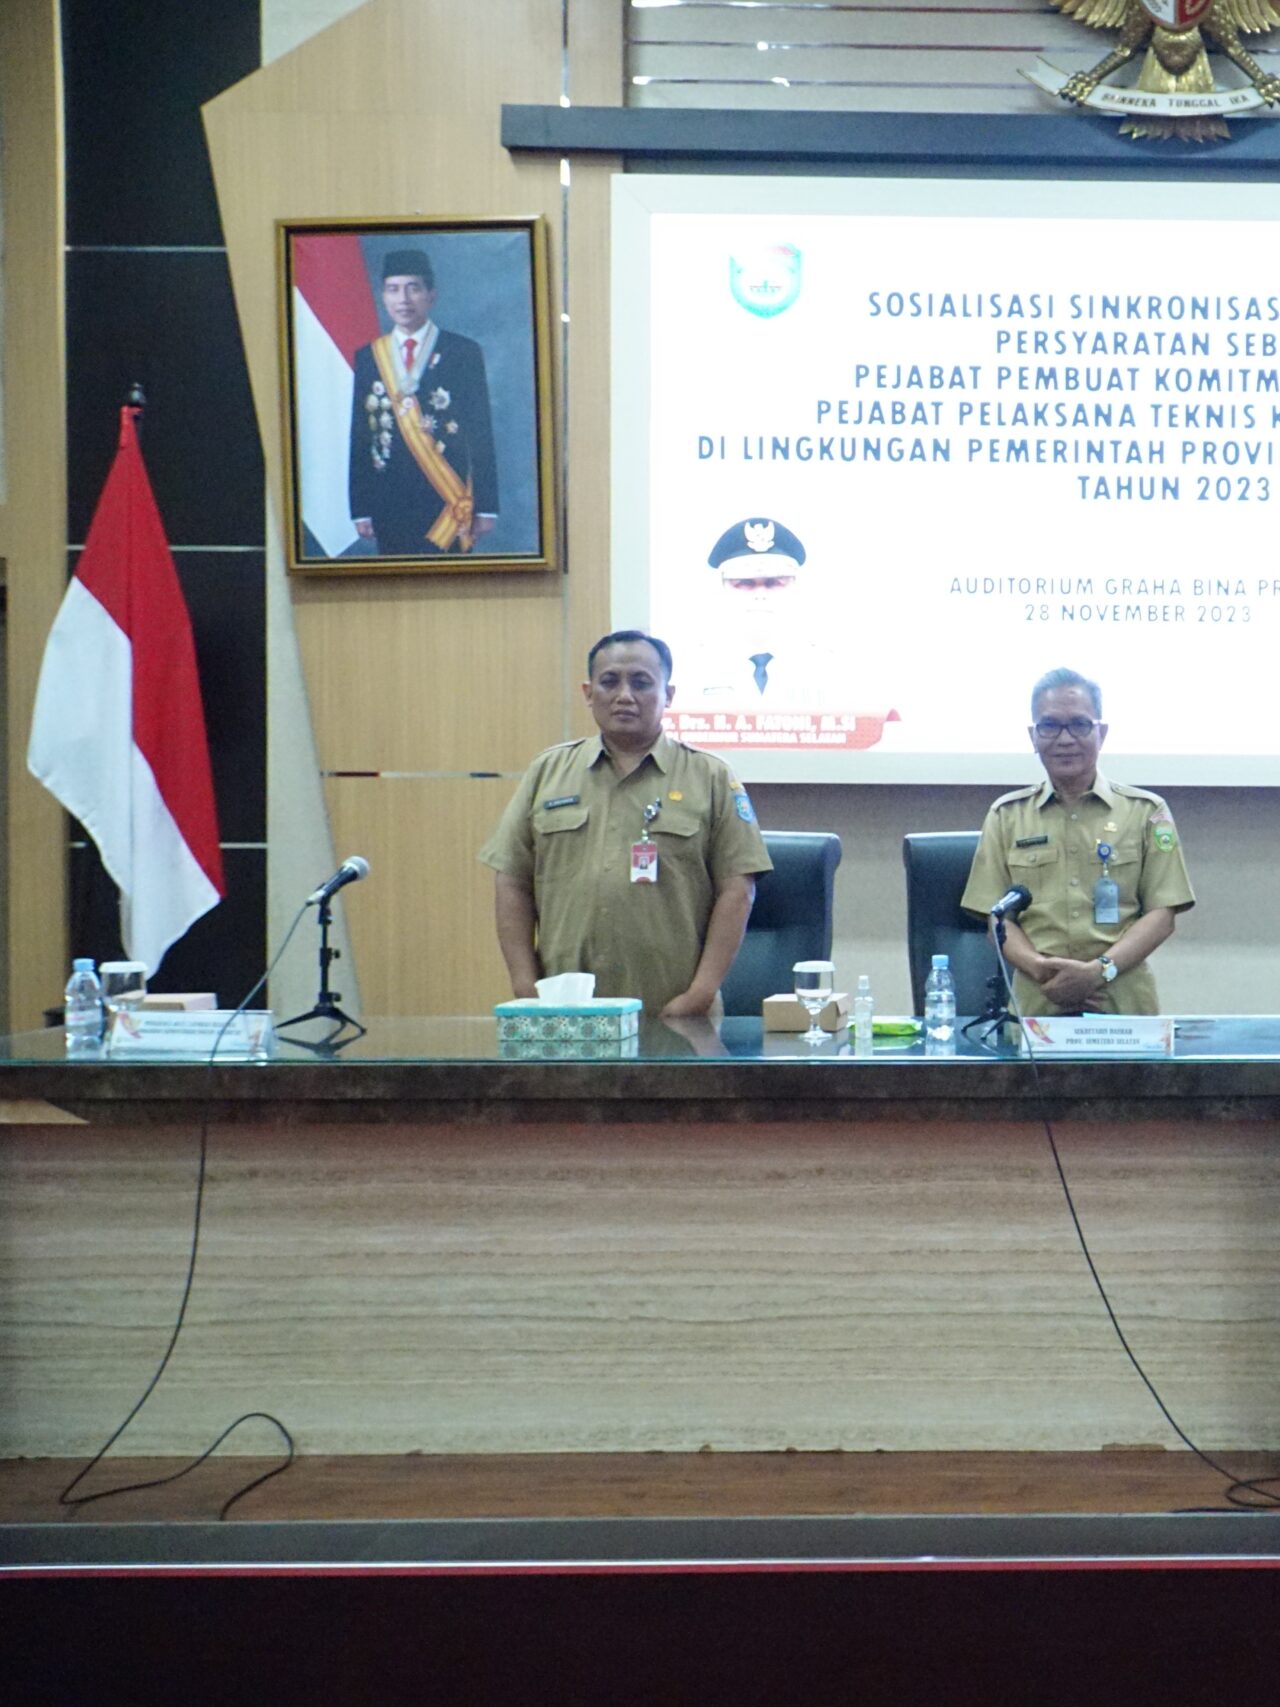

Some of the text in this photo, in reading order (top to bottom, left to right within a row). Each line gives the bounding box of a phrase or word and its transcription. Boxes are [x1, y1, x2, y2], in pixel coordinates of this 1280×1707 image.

[1168, 97, 1221, 108] TUNGGAL
[868, 291, 1054, 320] SOSIALISASI
[996, 329, 1210, 357] PERSYARATAN
[854, 363, 982, 390] PEJABAT
[996, 365, 1141, 393] PEMBUAT
[816, 399, 944, 426] PEJABAT
[958, 400, 1137, 428] PELAKSANA
[1149, 402, 1256, 430] TEKNIS
[697, 434, 726, 461] DI
[743, 435, 951, 463] LINGKUNGAN
[967, 437, 1165, 465] PEMERINTAH
[1076, 474, 1272, 503] TAHUN 2023
[950, 577, 1094, 596] AUDITORIUM
[1104, 578, 1183, 597] GRAHA
[1193, 579, 1248, 597] BINA
[1024, 604, 1252, 624] 28 NOVEMBER 2023
